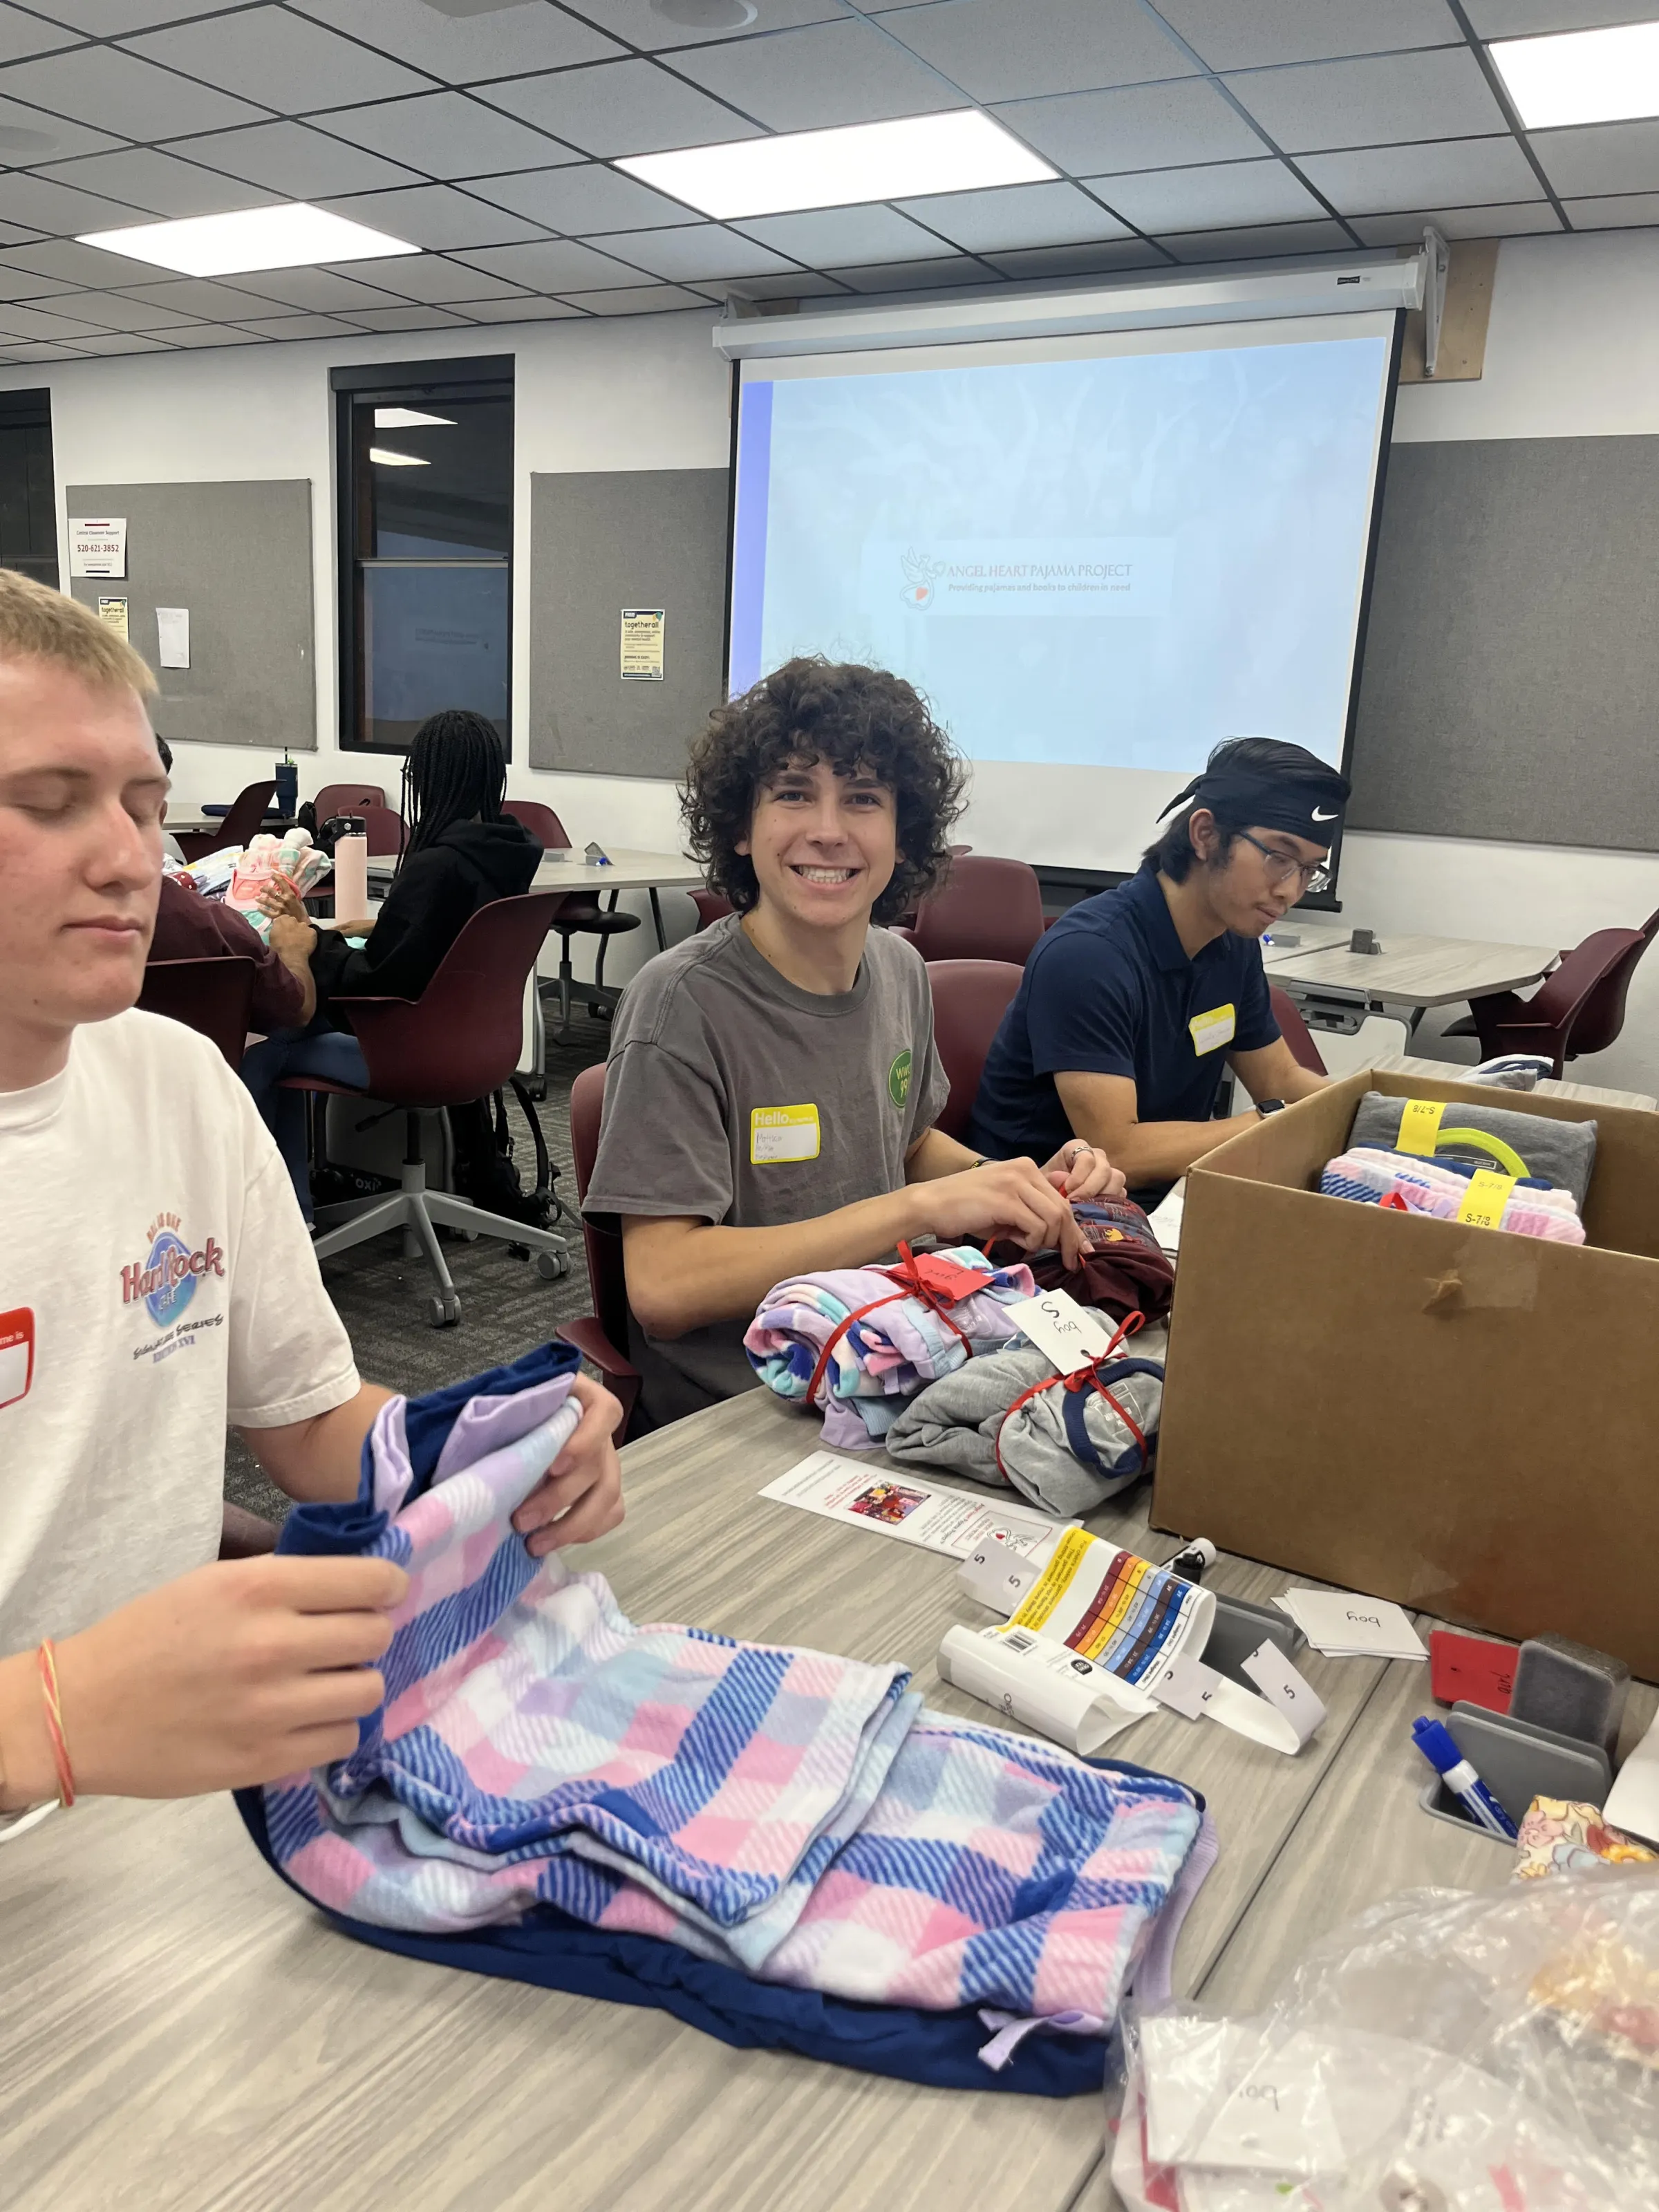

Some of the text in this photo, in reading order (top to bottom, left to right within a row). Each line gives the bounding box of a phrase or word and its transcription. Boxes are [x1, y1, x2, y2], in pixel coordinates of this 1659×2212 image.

[947, 564, 1133, 579] ANGEL HEART PAJAMA PROJECT
[948, 583, 984, 592] Providing
[984, 583, 1015, 593] pajamas
[1017, 583, 1031, 592] and
[1033, 583, 1056, 592] books
[1067, 583, 1099, 591] children
[1110, 583, 1131, 592] need
[1412, 1105, 1436, 1114] S-7/8
[754, 1110, 789, 1126] Hello
[1478, 1181, 1503, 1190] S-7/8
[1465, 1213, 1491, 1226] S-7/8
[1041, 1301, 1060, 1318] S
[176, 1313, 224, 1337] SERIES
[1053, 1320, 1083, 1335] boy
[14, 1329, 24, 1340] is
[973, 1553, 986, 1565] 5
[1008, 1575, 1022, 1589] 5
[1346, 1610, 1382, 1629] boy
[1490, 1671, 1512, 1696] girl
[1284, 1685, 1297, 1700] 5
